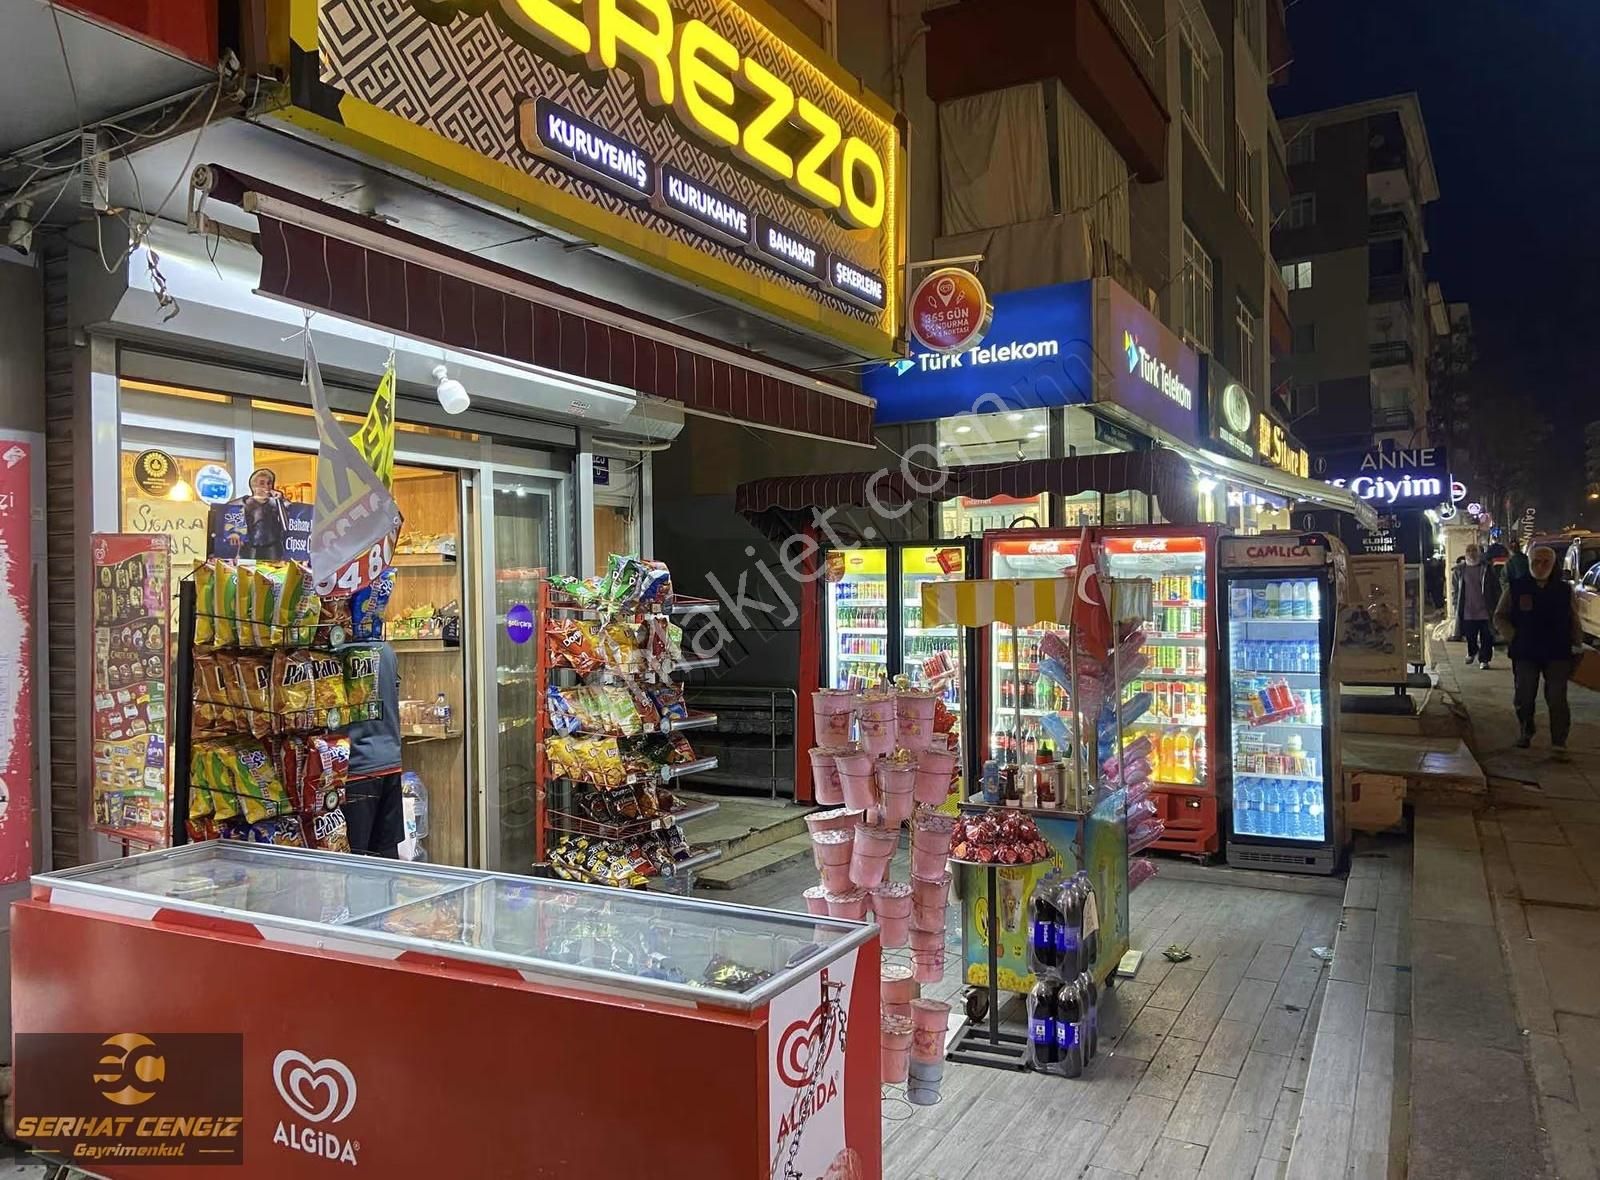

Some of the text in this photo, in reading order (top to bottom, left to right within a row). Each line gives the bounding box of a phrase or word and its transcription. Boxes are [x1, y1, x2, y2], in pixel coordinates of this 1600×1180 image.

[547, 114, 648, 187] KURUYEMİŞ
[668, 175, 747, 234] KURUKAHVE
[768, 229, 817, 269] BAHARAT
[835, 262, 882, 300] ŞEKERLEME
[946, 307, 969, 320] GÜN
[918, 337, 1059, 372] Türk Telekom
[1138, 345, 1192, 411] Türk Telekom
[1361, 448, 1436, 471] ANNE
[1351, 474, 1440, 504] Giyim
